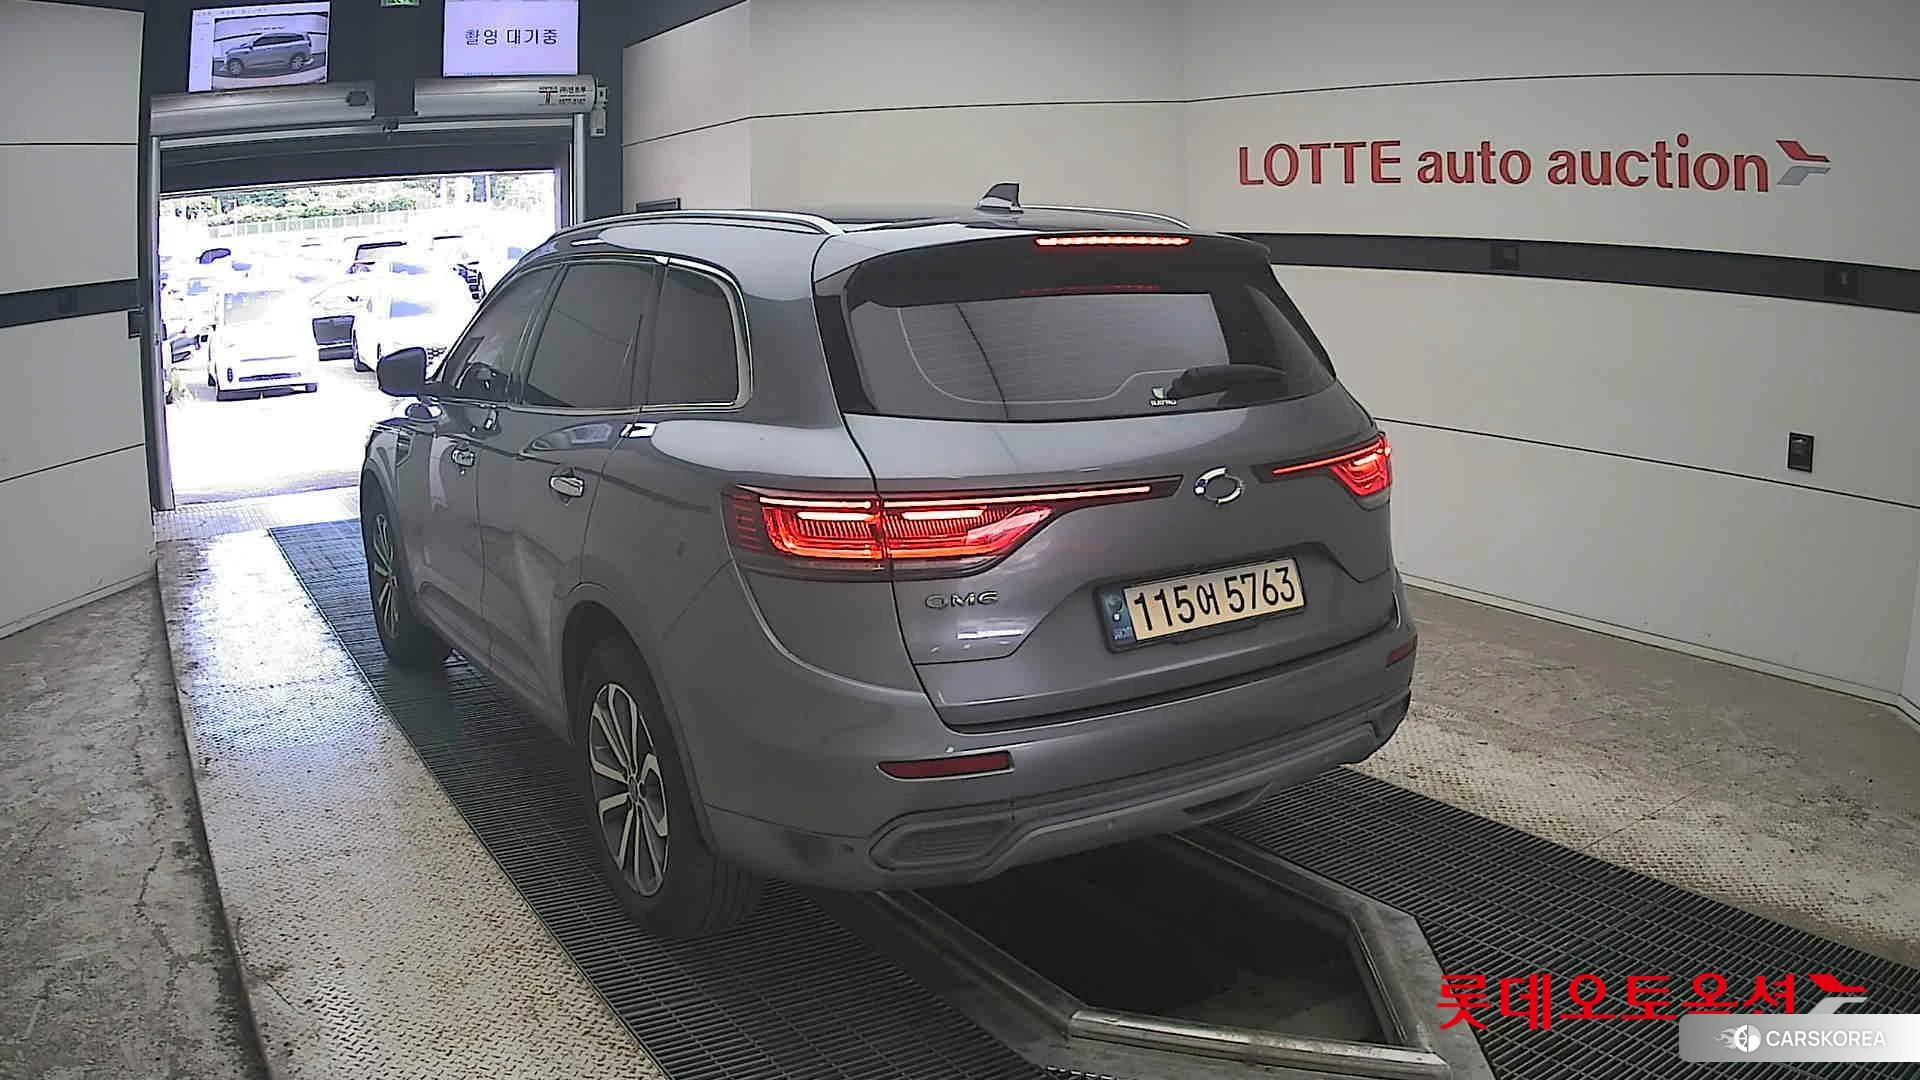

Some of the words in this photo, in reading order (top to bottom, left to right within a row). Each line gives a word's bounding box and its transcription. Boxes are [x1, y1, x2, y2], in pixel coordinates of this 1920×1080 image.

[506, 28, 558, 45] 대기중
[1239, 141, 1401, 187] LOTTE
[1416, 140, 1533, 185] auto
[1548, 133, 1770, 193] auction
[1223, 566, 1297, 614] 5763
